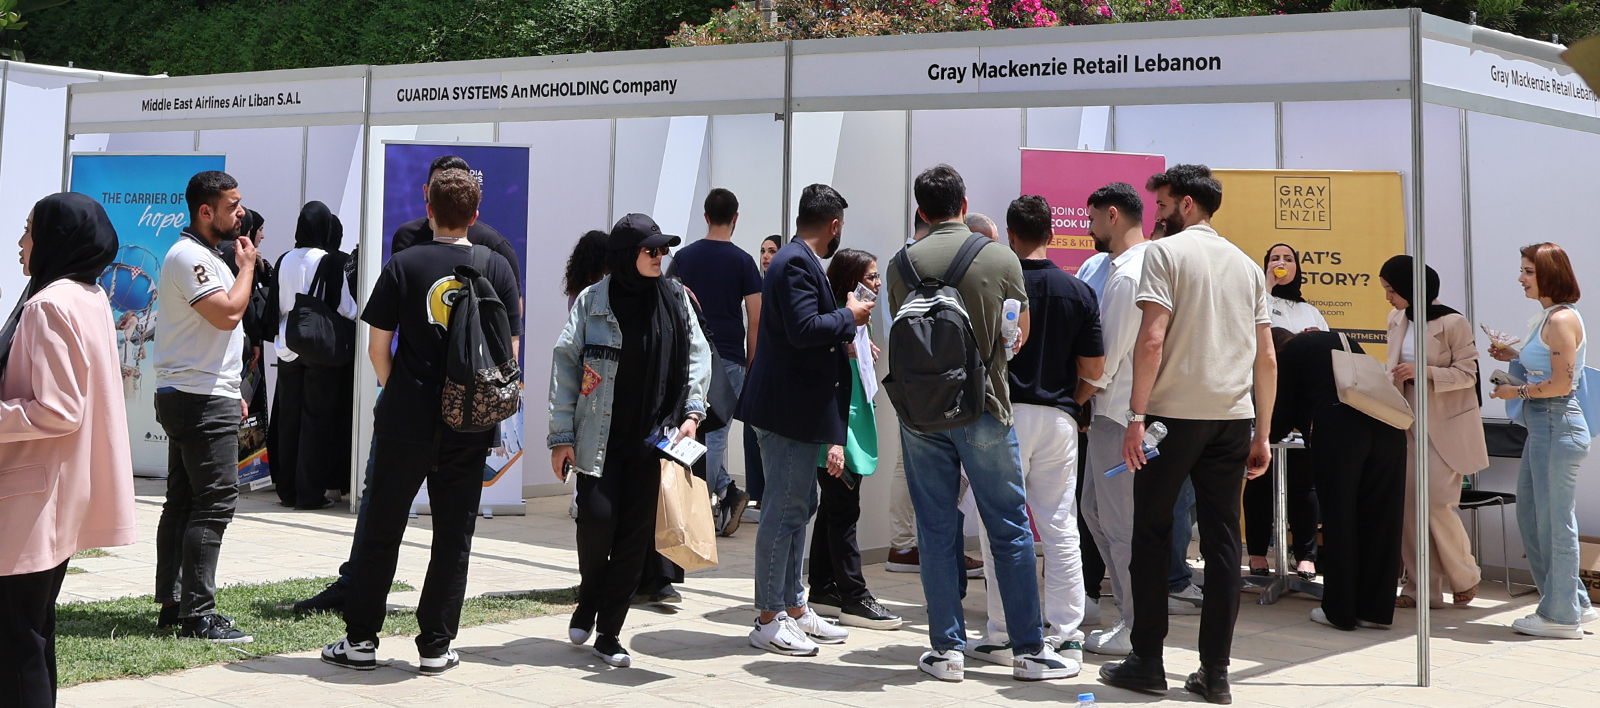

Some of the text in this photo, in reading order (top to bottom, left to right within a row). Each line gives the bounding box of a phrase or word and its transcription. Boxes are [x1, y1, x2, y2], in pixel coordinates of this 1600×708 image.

[927, 53, 1221, 84] Gray Mackenzie Retail Lebanon
[1490, 65, 1510, 88] Gray
[1511, 69, 1551, 93] Mackenzie
[1551, 78, 1573, 98] Retail
[396, 87, 450, 103] GUARDIA
[452, 84, 508, 101] SYSTEMS
[612, 78, 678, 96] Company
[141, 92, 301, 112] Middle East Airlines Air Liban S.A.L
[102, 192, 185, 205] THE CARRIER OF
[1279, 185, 1326, 197] GRAY
[1051, 206, 1075, 216] JOIN
[1280, 198, 1325, 209] MACK
[137, 204, 187, 237] hope
[1280, 210, 1326, 222] ENZIE
[1070, 238, 1077, 247] &
[193, 264, 210, 286] 2
